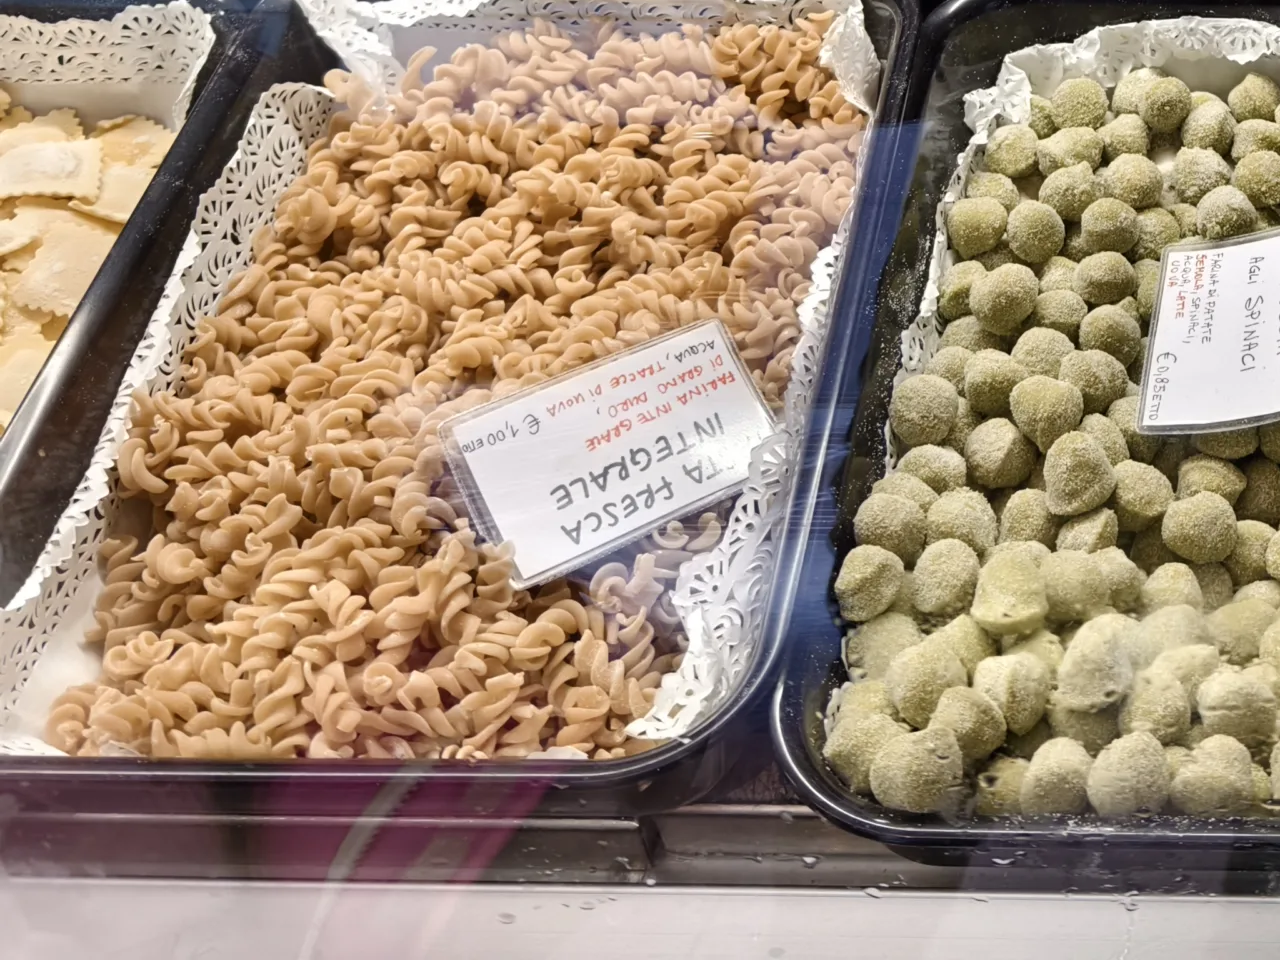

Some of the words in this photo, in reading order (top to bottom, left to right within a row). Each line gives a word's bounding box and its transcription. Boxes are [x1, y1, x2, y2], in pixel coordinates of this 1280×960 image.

[1167, 260, 1180, 288] UOVA
[1175, 290, 1188, 319] LATTE
[1201, 301, 1215, 344] PATATE
[609, 360, 666, 389] TRACCE
[658, 366, 703, 395] GRANO
[545, 393, 585, 419] UOVA
[550, 412, 726, 510] INTEGRALE
[560, 475, 675, 545] FRESCA
